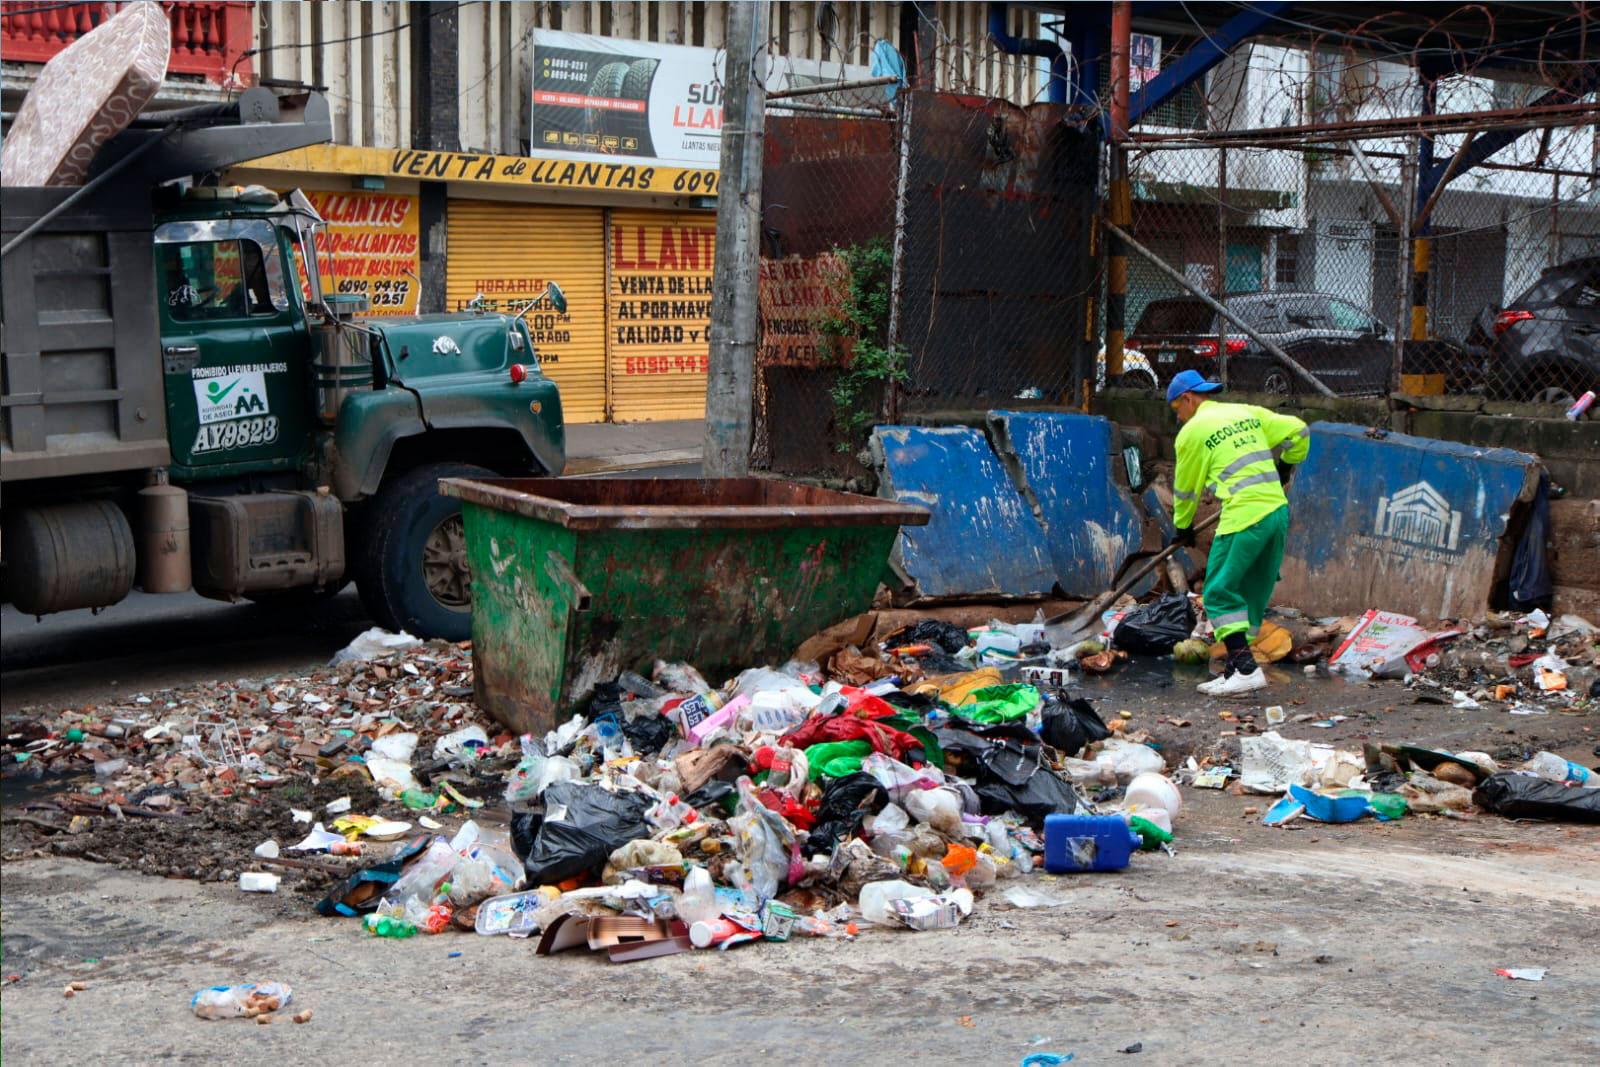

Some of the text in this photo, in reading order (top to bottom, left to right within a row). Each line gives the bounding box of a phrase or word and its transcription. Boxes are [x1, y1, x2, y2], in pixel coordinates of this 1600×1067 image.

[682, 140, 706, 151] LLANTAS
[392, 150, 720, 193] VENTA de LLANTAS 609
[319, 194, 411, 226] LLANTAS
[353, 232, 418, 254] LLANTAS
[475, 279, 544, 292] HORARIO
[618, 276, 664, 294] VENTA
[668, 276, 685, 294] DE
[618, 301, 637, 319] AL
[641, 301, 669, 319] POR
[617, 325, 684, 343] CALIDAD
[191, 362, 288, 379] PROHIBIDO LLEVAR PASAJEROS
[202, 410, 233, 421] DE ASEO
